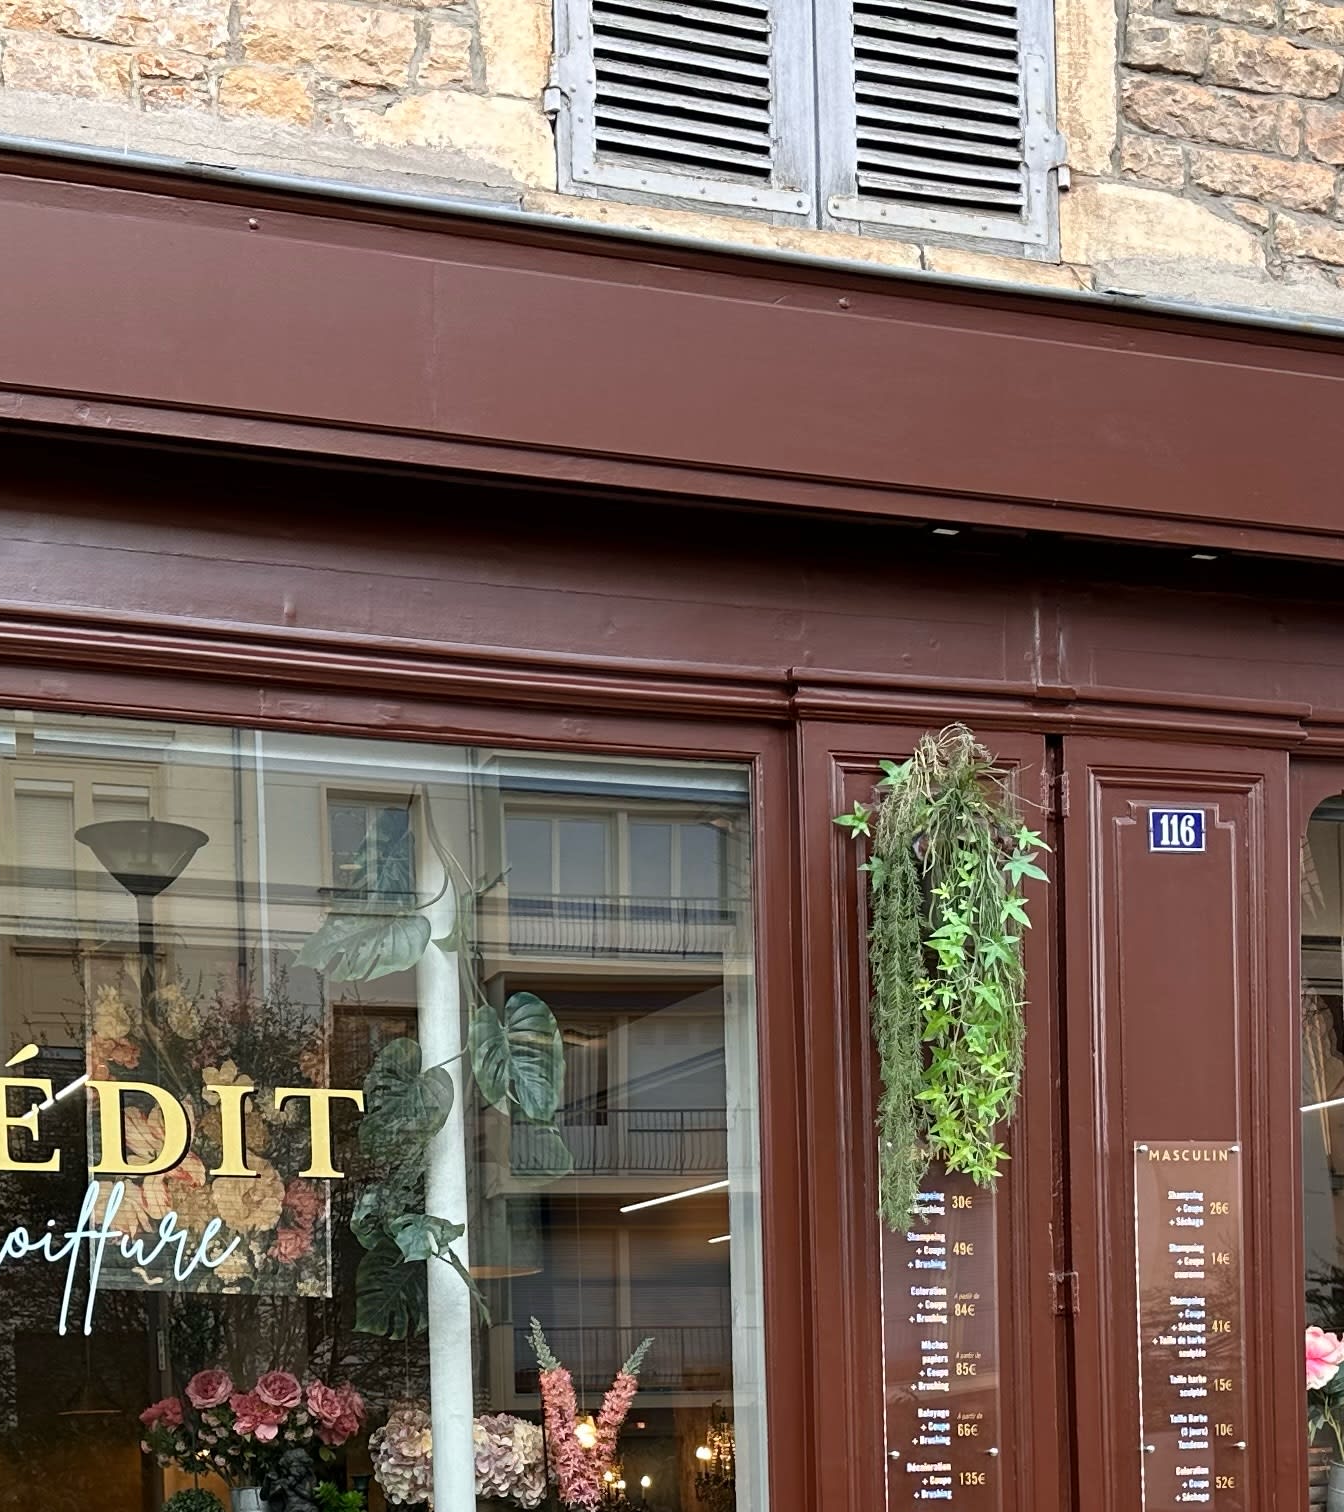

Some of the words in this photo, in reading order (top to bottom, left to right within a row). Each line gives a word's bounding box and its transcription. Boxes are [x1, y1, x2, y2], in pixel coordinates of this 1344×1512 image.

[1160, 814, 1196, 846] 116
[1148, 1149, 1228, 1161] MASCULIN
[952, 1196, 973, 1209] 30€
[1209, 1202, 1229, 1215] 26€
[924, 1245, 946, 1257] Coupe
[953, 1242, 974, 1256] 49€
[915, 1259, 947, 1271] Brushing
[1211, 1252, 1231, 1265] 14€
[955, 1303, 975, 1317] 84€
[1212, 1320, 1231, 1333] 41€
[956, 1363, 977, 1376] 85€
[1214, 1378, 1232, 1391] 15€
[928, 1421, 951, 1433] Coupe
[958, 1423, 979, 1437] 66€
[1215, 1423, 1233, 1436] 10€
[929, 1476, 952, 1487] Coupe
[959, 1472, 986, 1486] 135€
[1215, 1476, 1235, 1489] 52€
